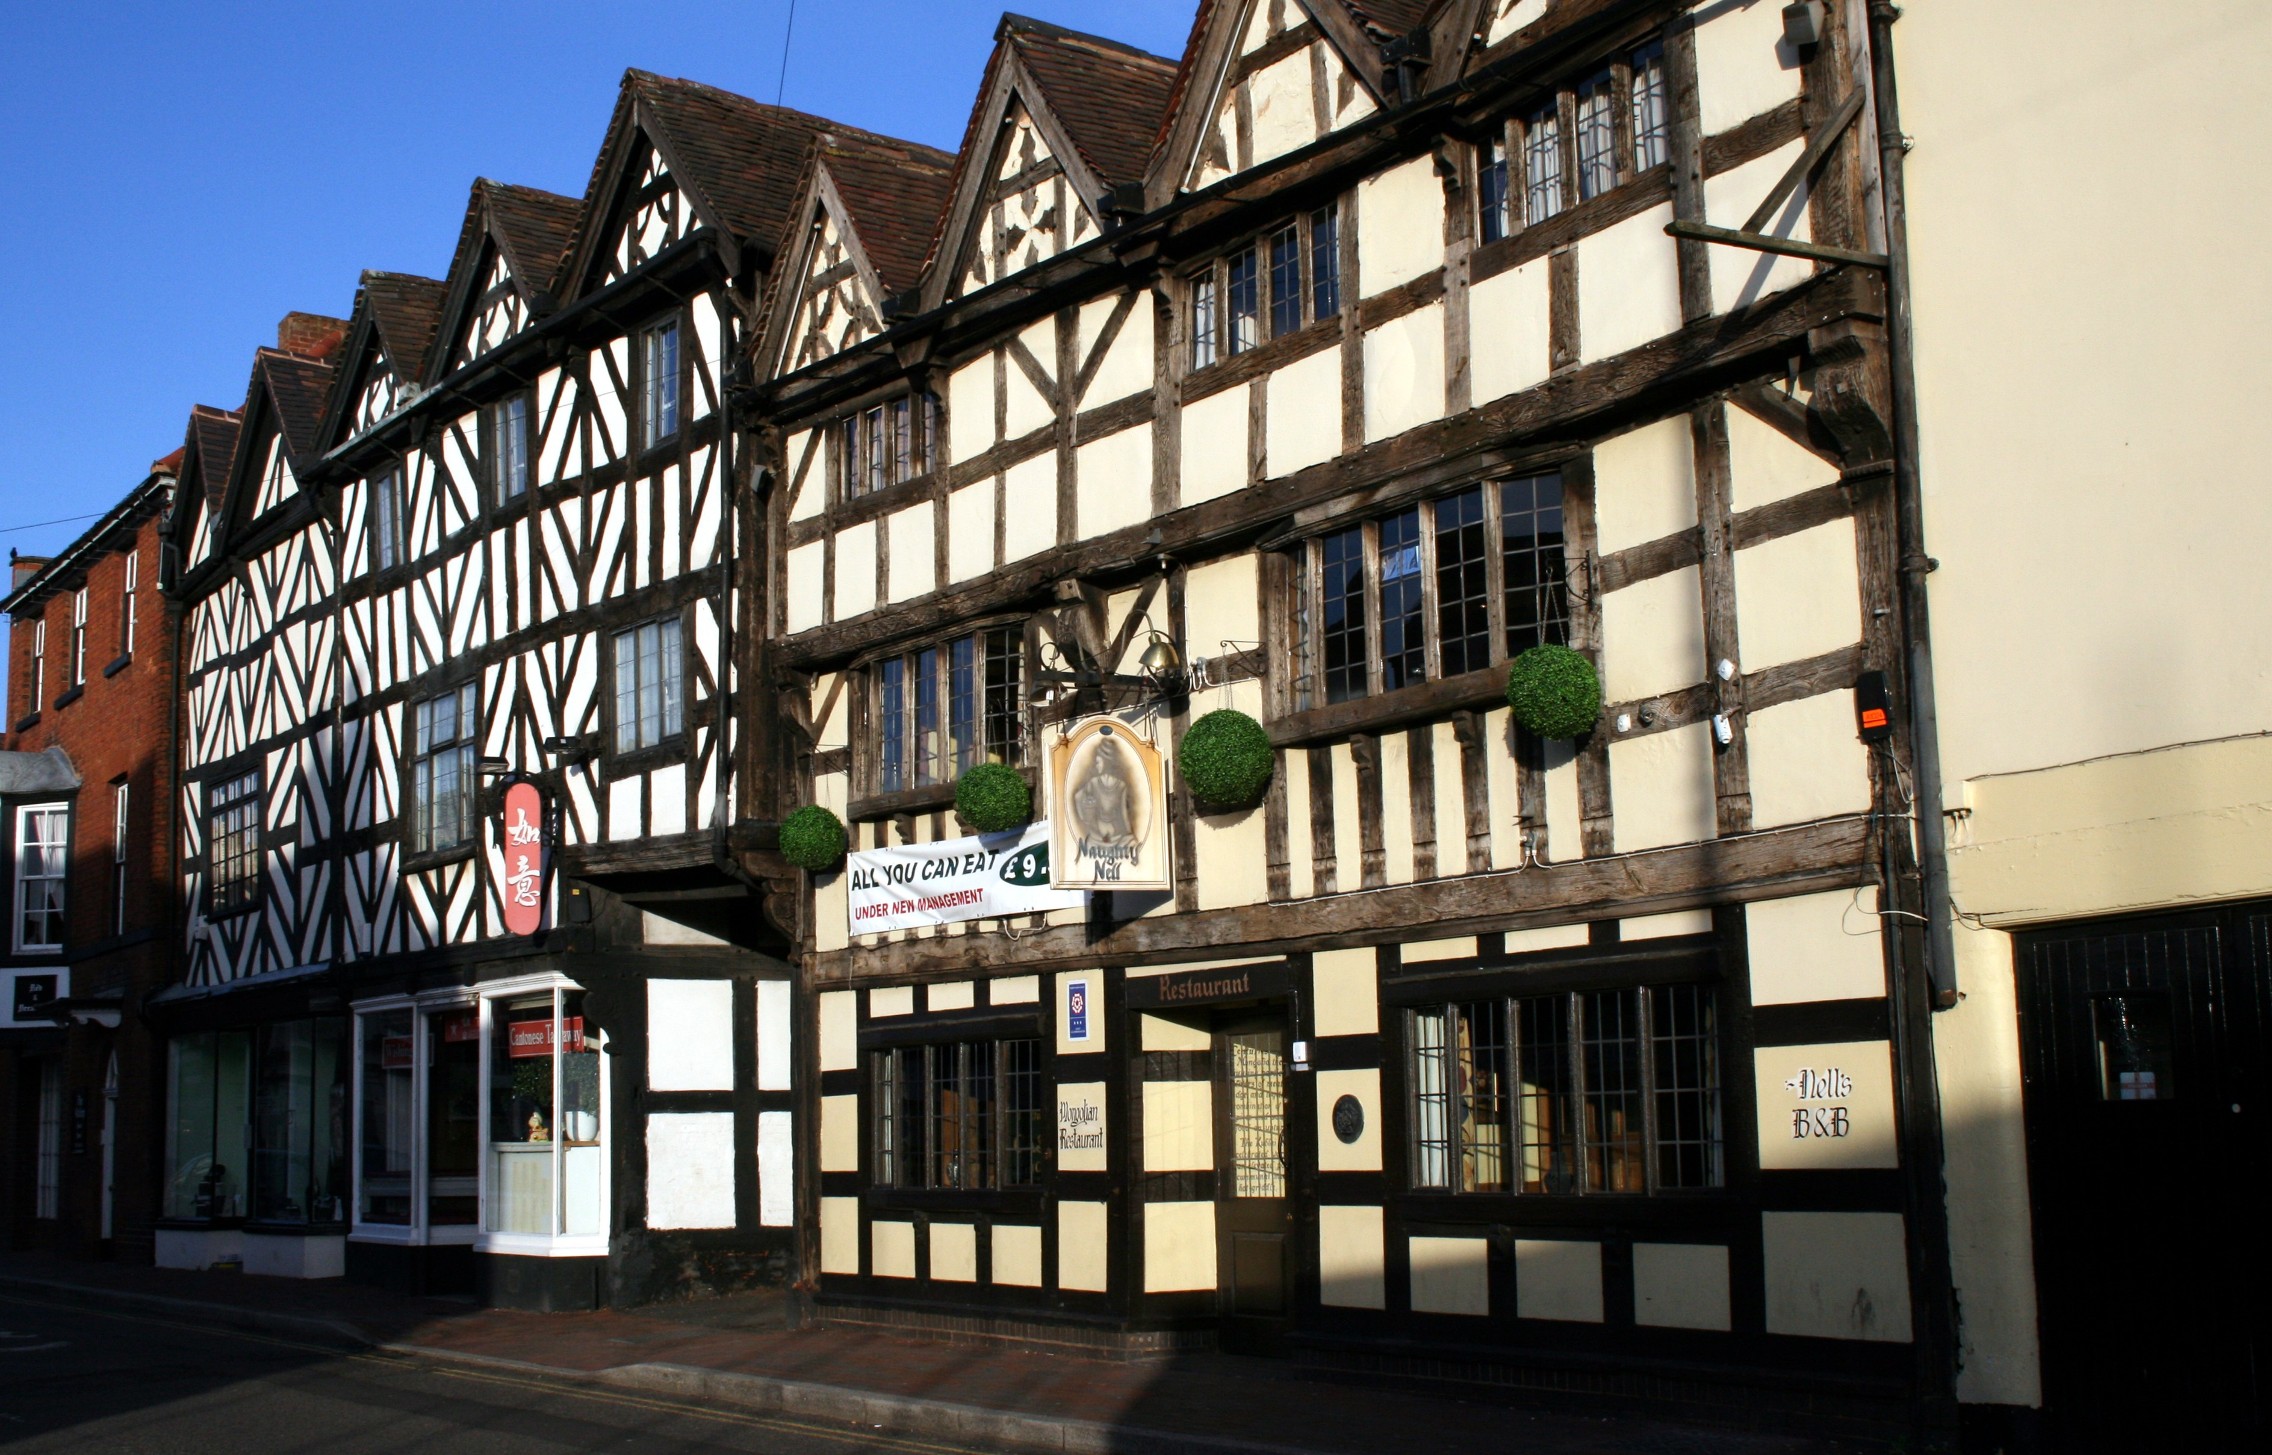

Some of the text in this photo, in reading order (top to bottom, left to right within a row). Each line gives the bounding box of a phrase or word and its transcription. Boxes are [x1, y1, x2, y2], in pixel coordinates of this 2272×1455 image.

[507, 808, 540, 907] 如意
[1075, 833, 1141, 866] Naughty
[852, 849, 999, 891] ALL YOU CAN EAT
[1092, 860, 1121, 886] Nell
[855, 888, 983, 920] UNDER NEW MANAGEMENT
[1160, 973, 1249, 1000] Restaurant
[511, 1028, 544, 1046] Cantonese
[1060, 1099, 1098, 1127] Mongolian
[1792, 1107, 1849, 1139] B&B
[1060, 1127, 1103, 1149] Restaurant
